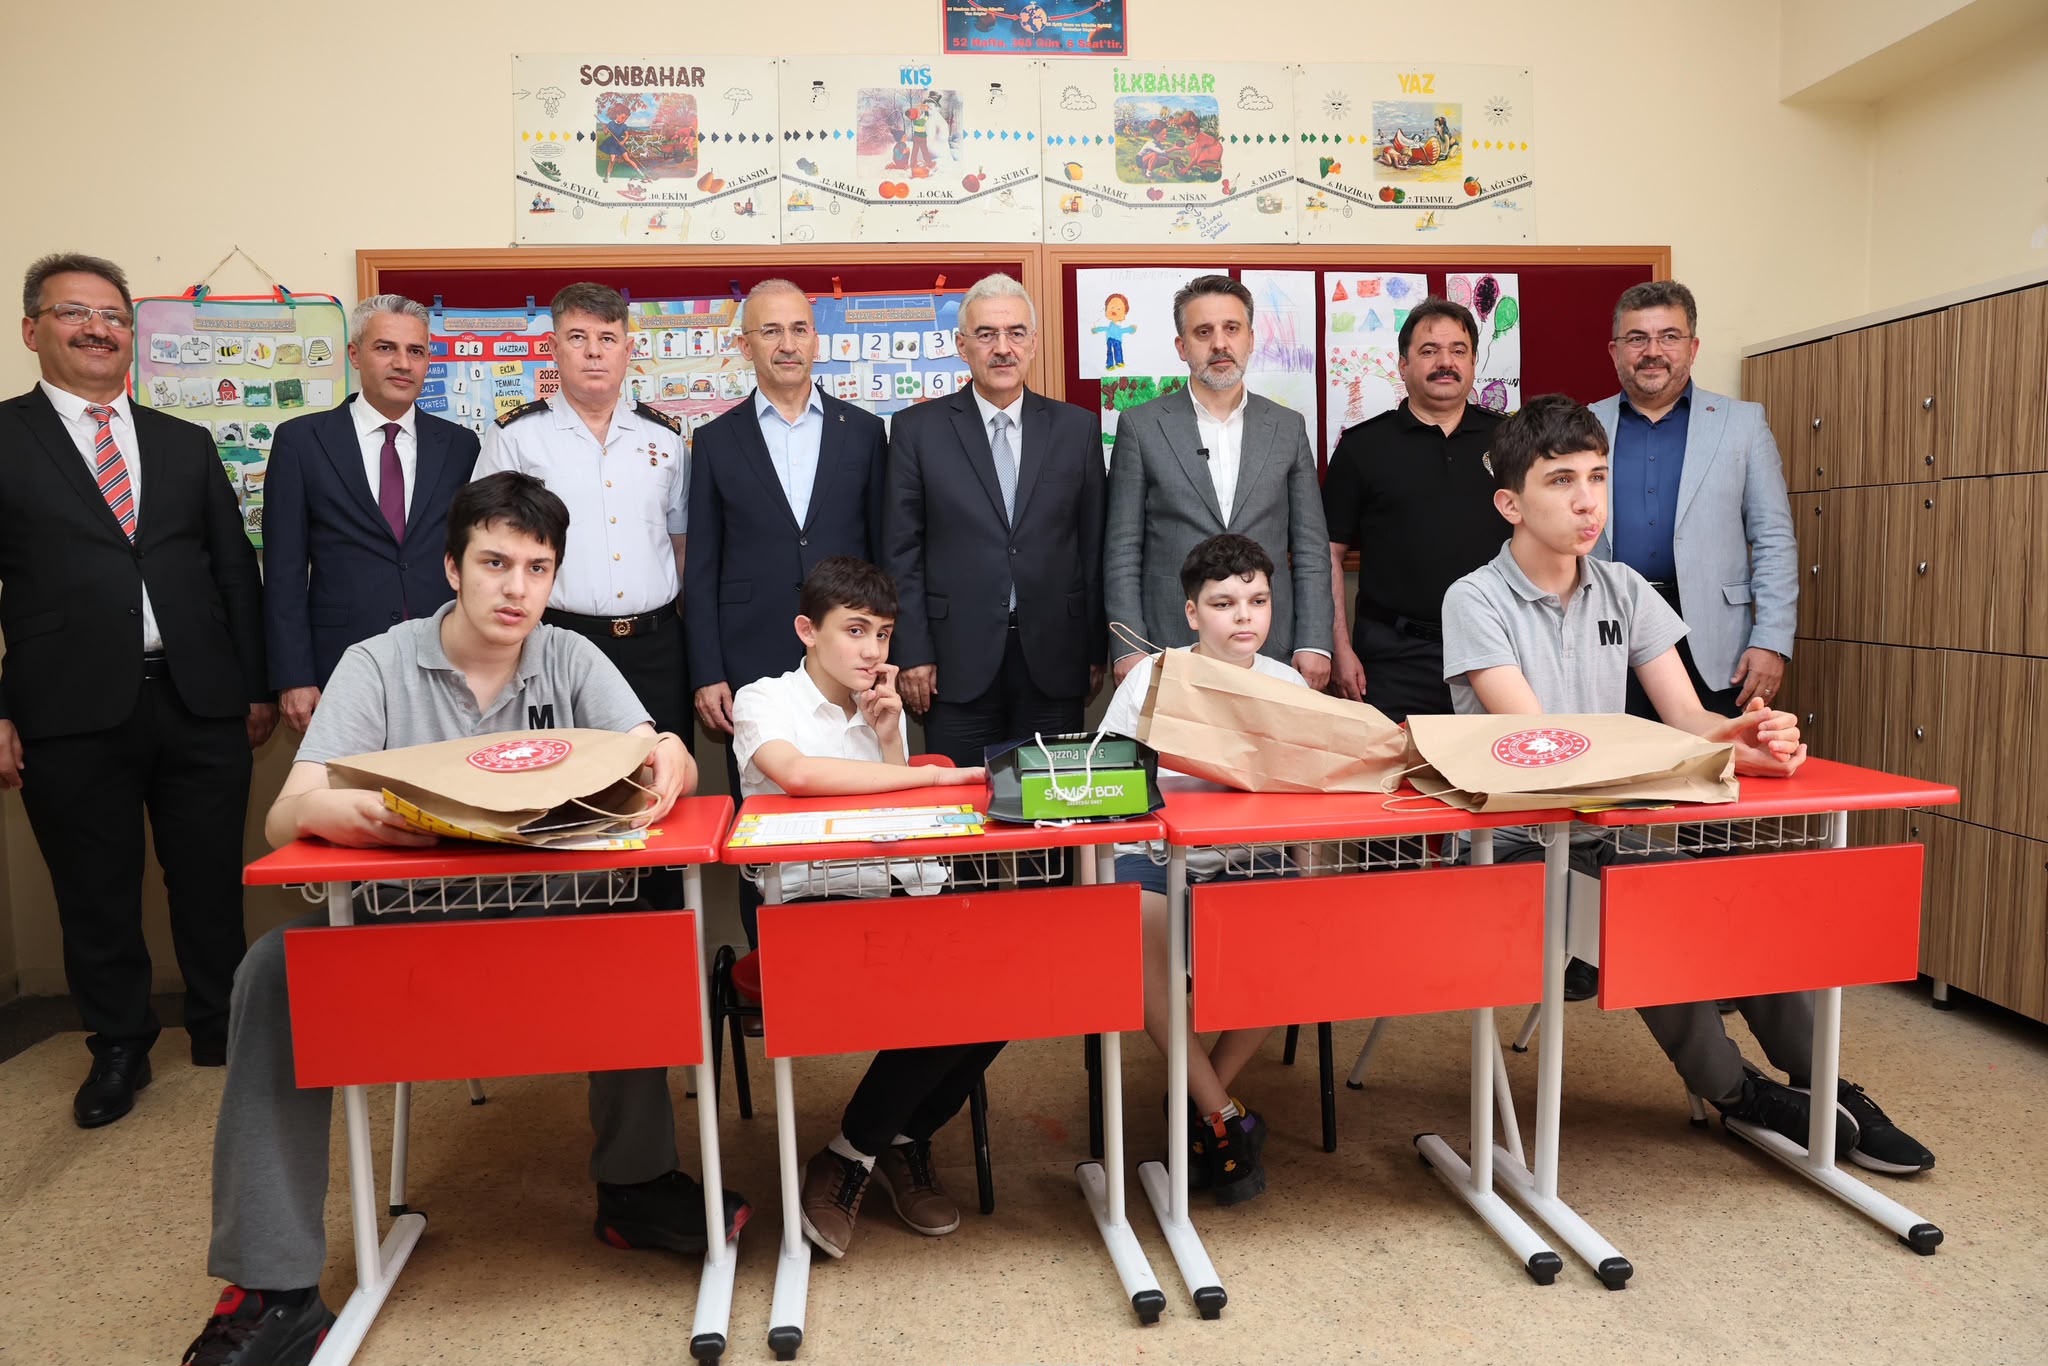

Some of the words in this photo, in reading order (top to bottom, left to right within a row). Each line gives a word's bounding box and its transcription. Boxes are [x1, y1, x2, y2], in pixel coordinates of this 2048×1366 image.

[953, 38, 968, 48] 52
[1067, 39, 1074, 48] 6
[580, 64, 706, 88] SONBAHAR
[900, 64, 932, 91] KIŞ
[1113, 67, 1215, 93] İLKBAHAR
[1398, 74, 1435, 94] YAZ
[738, 168, 769, 184] KASIM
[1001, 167, 1030, 183] ŞUBAT
[1259, 169, 1287, 184] MAYIS
[1490, 173, 1528, 191] AĞUSTOS
[570, 183, 600, 200] EYLÜL
[832, 181, 867, 197] ARALIK
[926, 190, 953, 199] OCAK
[1101, 185, 1129, 200] MART
[1335, 182, 1374, 201] HAZİRAN
[662, 192, 688, 201] EKİM
[1179, 193, 1207, 201] NİSAN
[870, 334, 882, 351] 2
[932, 332, 945, 348] 3
[460, 345, 465, 354] 2
[473, 345, 479, 354] 6
[499, 344, 528, 353] HAZİRAN
[475, 369, 480, 378] 0
[500, 365, 516, 375] EKİM
[540, 370, 559, 380] 2022
[458, 382, 462, 391] 1
[495, 379, 521, 388] TEMMUZ
[815, 375, 825, 388] 4
[872, 375, 883, 391] 5
[932, 374, 944, 390] 6
[871, 391, 884, 399] BEŞ
[462, 405, 466, 414] 1
[501, 400, 521, 408] KASIM
[476, 408, 481, 417] 2
[475, 423, 480, 432] 4
[1598, 619, 1623, 646] M
[528, 703, 554, 730] M
[1098, 748, 1105, 759] 3
[1095, 785, 1125, 797] BOX
